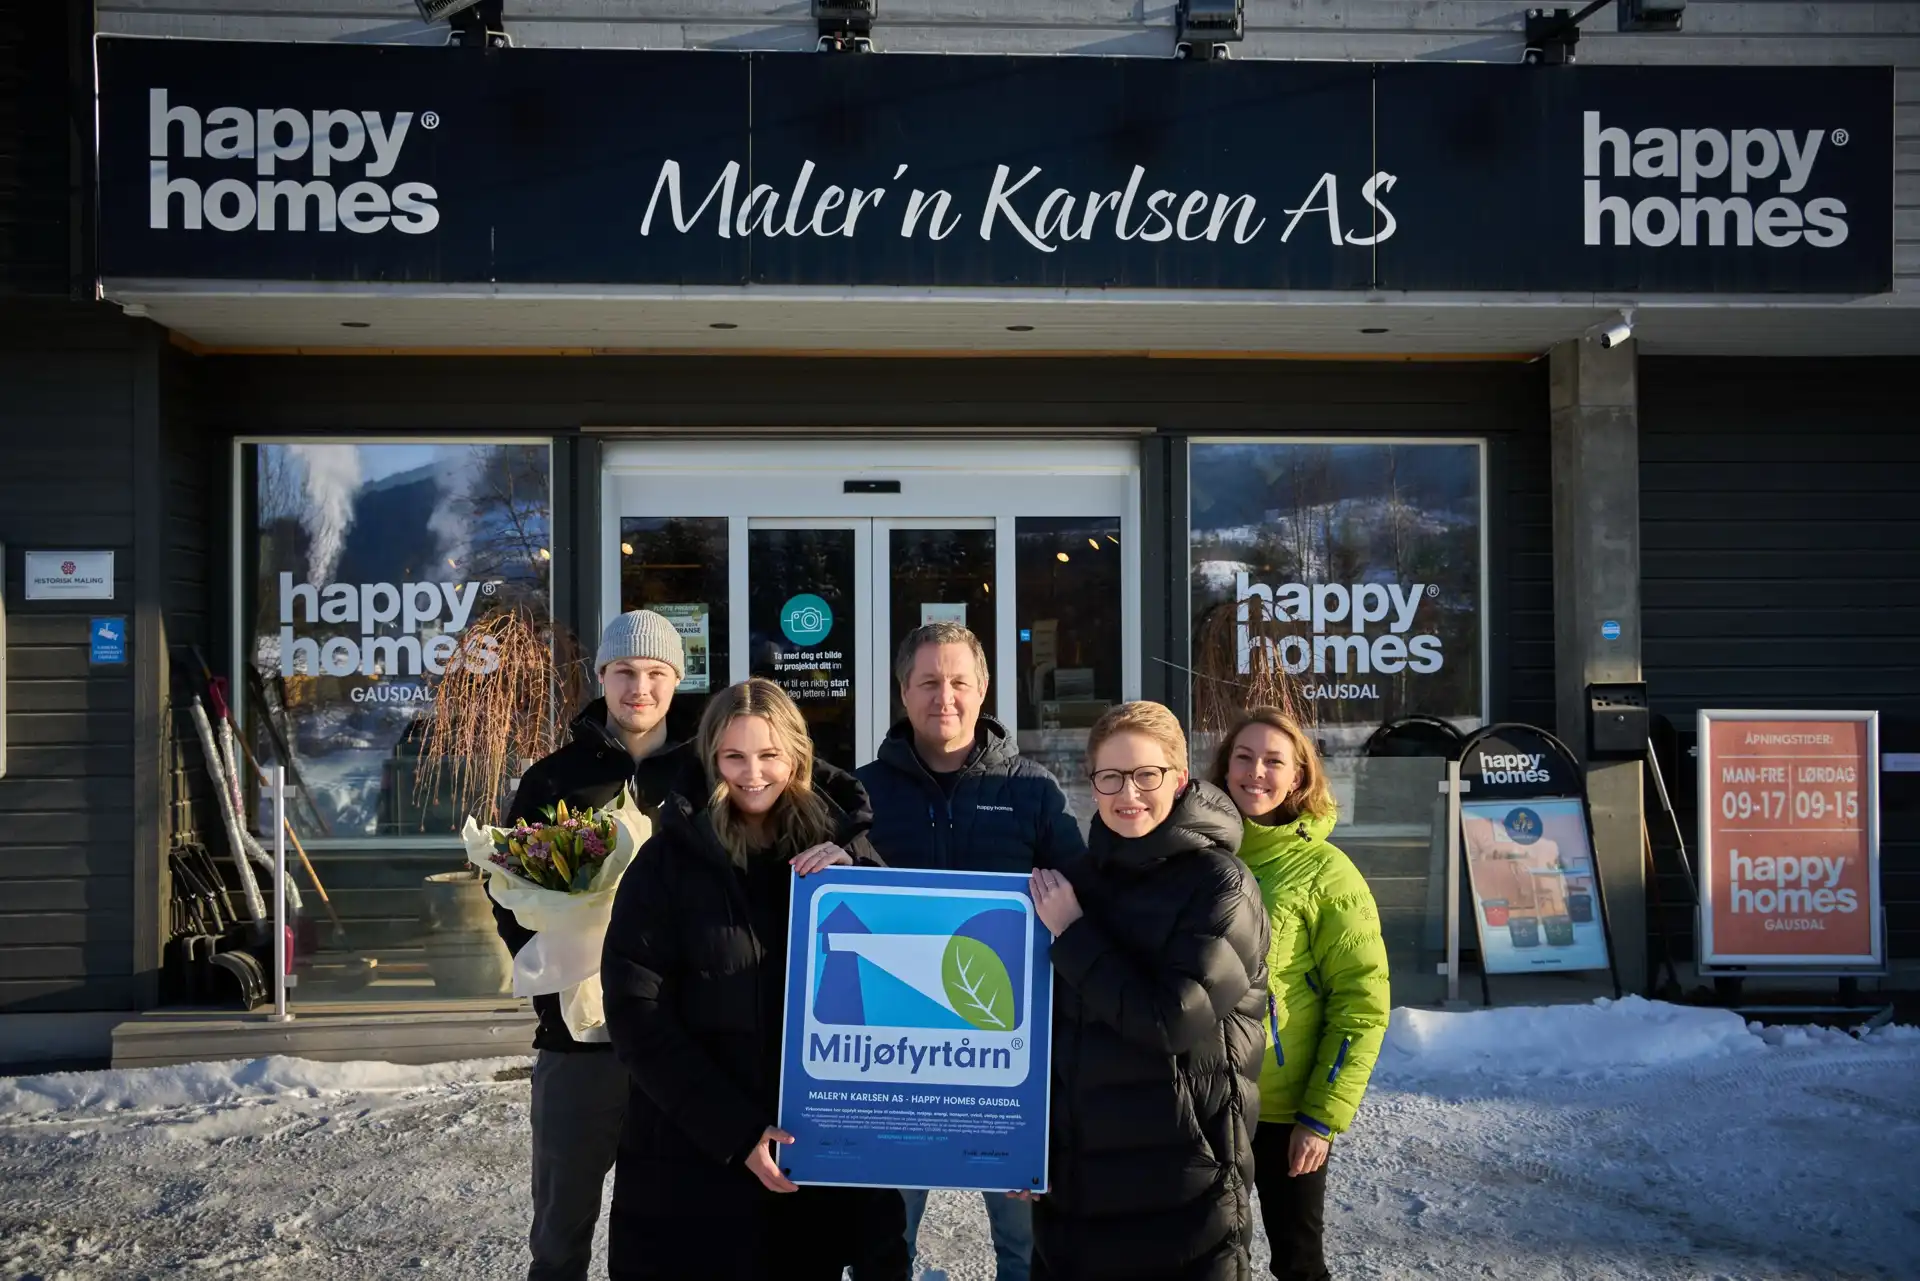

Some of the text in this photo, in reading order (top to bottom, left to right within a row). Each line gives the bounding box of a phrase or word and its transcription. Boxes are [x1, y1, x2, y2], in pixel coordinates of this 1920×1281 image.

[150, 160, 440, 234] homes
[980, 164, 1266, 252] Karlsen
[1280, 171, 1397, 246] AS
[1584, 179, 1849, 248] homes
[280, 625, 500, 677] homes
[774, 651, 842, 660] Ta med deg et bilde
[1237, 623, 1444, 674] homes
[784, 662, 818, 671] prosjektet
[820, 662, 831, 670] ditt
[810, 679, 829, 689] riktig
[830, 679, 849, 687] start
[1303, 683, 1379, 700] GAUSDAL
[351, 686, 433, 703] GAUSDAL
[788, 690, 801, 699] deg
[803, 689, 825, 697] lettere
[831, 688, 847, 697] mål
[1745, 730, 1833, 745] ÅPNINGSTIDER:
[1479, 752, 1541, 770] happy
[1481, 768, 1550, 784] homes
[1722, 766, 1857, 783] MAN-FRE LØRDAG
[1722, 791, 1858, 819] 09-17 09-15
[1730, 881, 1858, 914] homes
[1764, 918, 1826, 931] GAUSDAL
[809, 1091, 848, 1101] MALER'N
[850, 1093, 889, 1102] KARLSEN
[892, 1094, 904, 1103] AS
[911, 1095, 941, 1104] HAPPY
[943, 1097, 976, 1106] HOMES
[978, 1098, 1021, 1107] GAUSDAL
